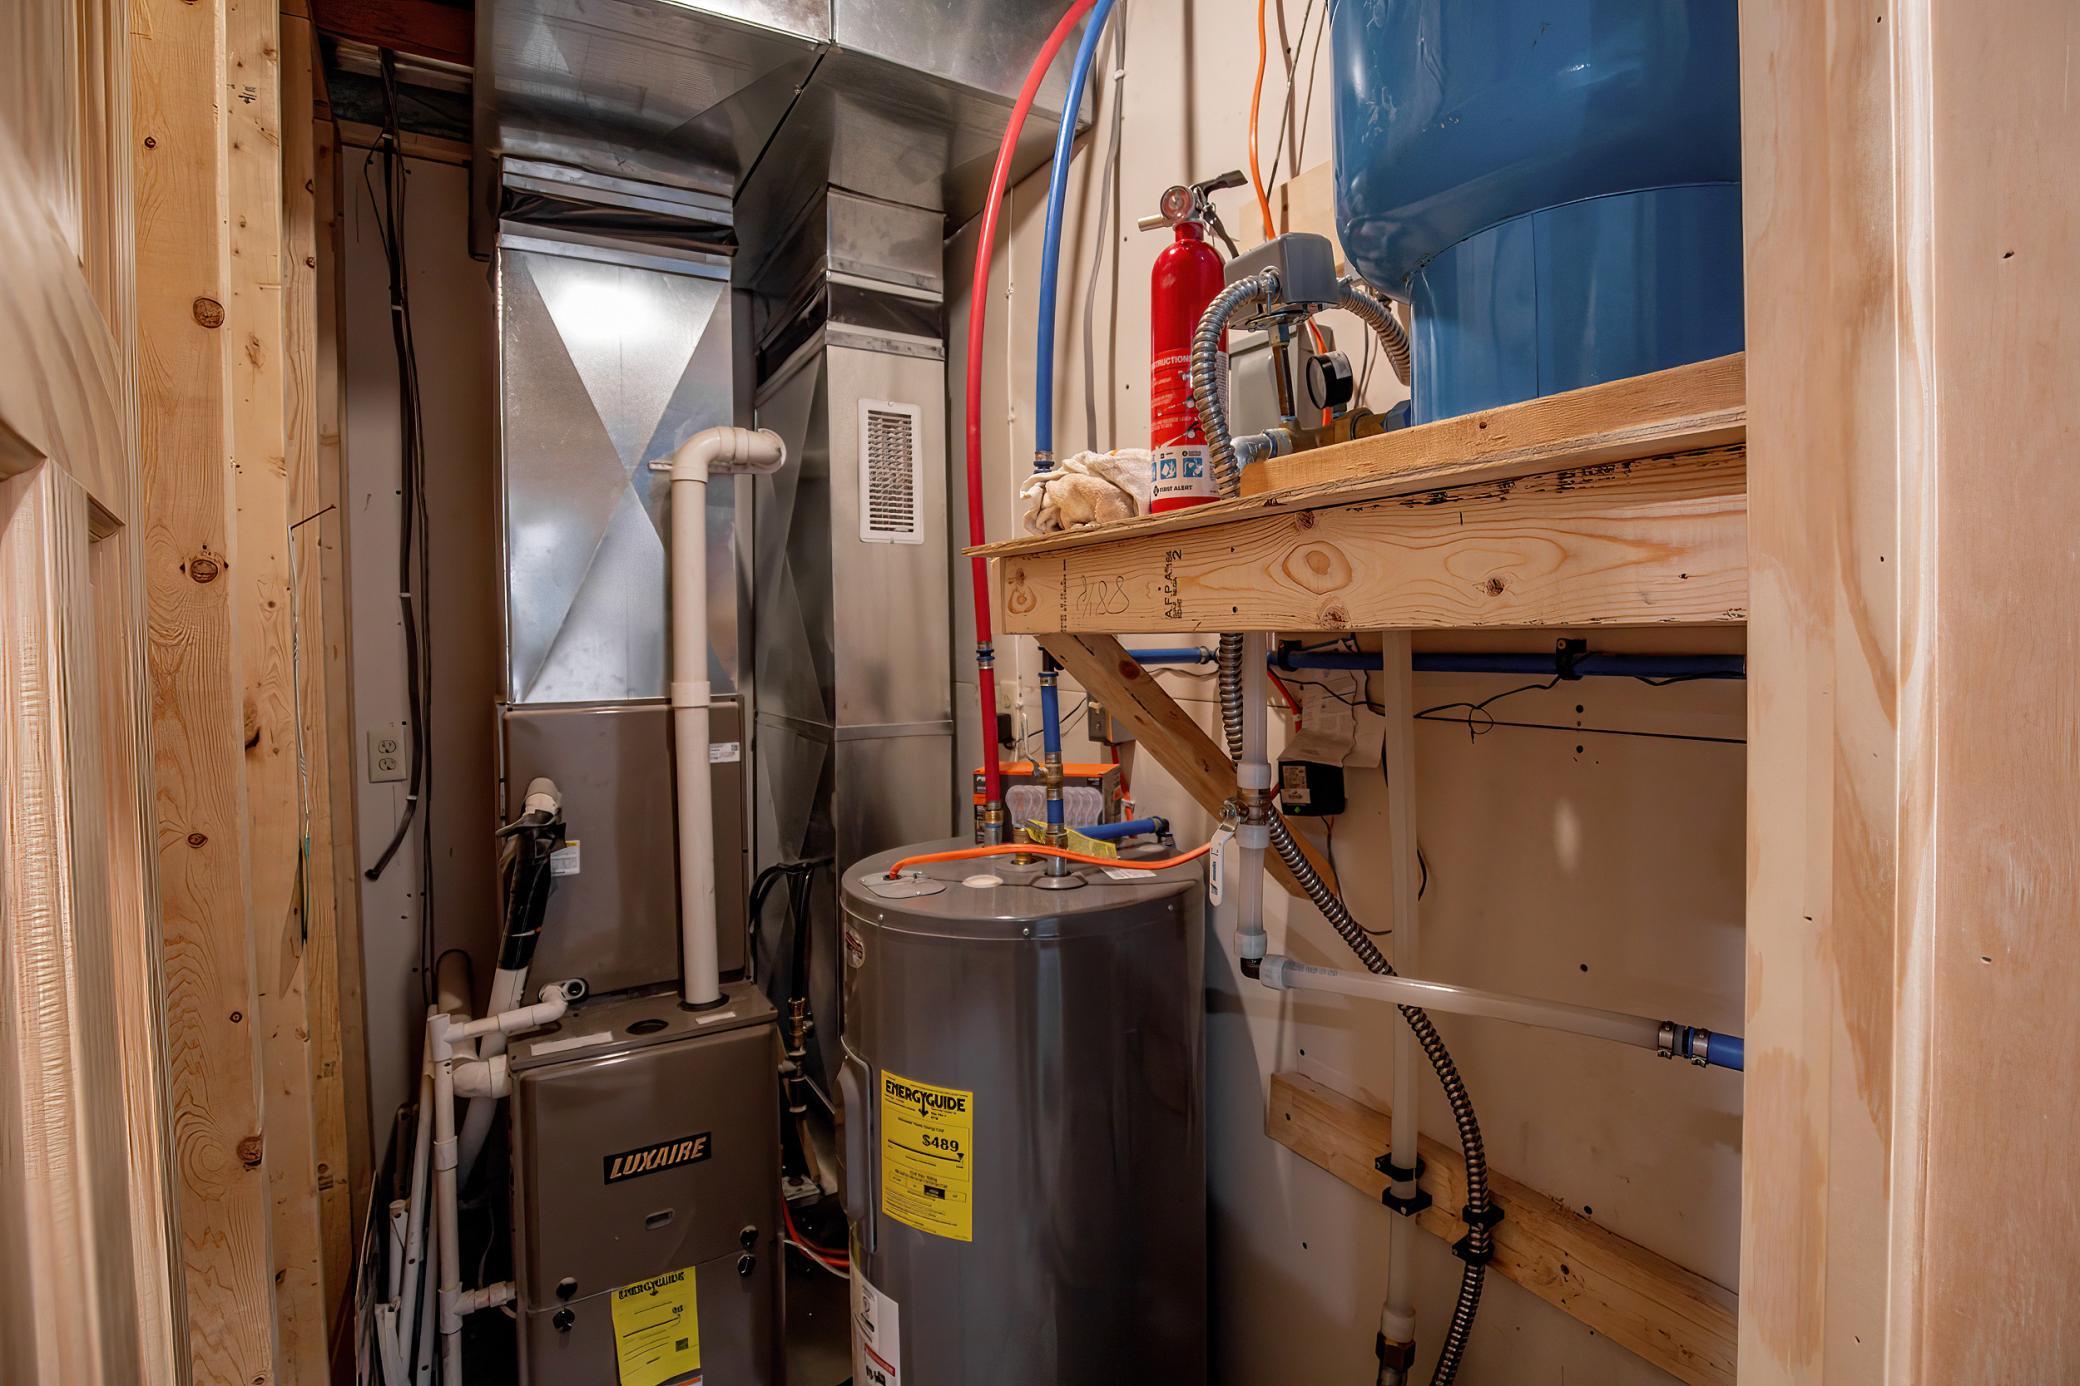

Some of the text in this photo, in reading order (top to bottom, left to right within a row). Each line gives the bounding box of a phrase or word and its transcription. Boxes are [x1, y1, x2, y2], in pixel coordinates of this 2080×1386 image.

[1172, 549, 1182, 561] 2
[885, 1080, 966, 1113] ENERGYGUIDE
[922, 1134, 959, 1152] $489
[610, 1136, 707, 1179] LUXAIRE
